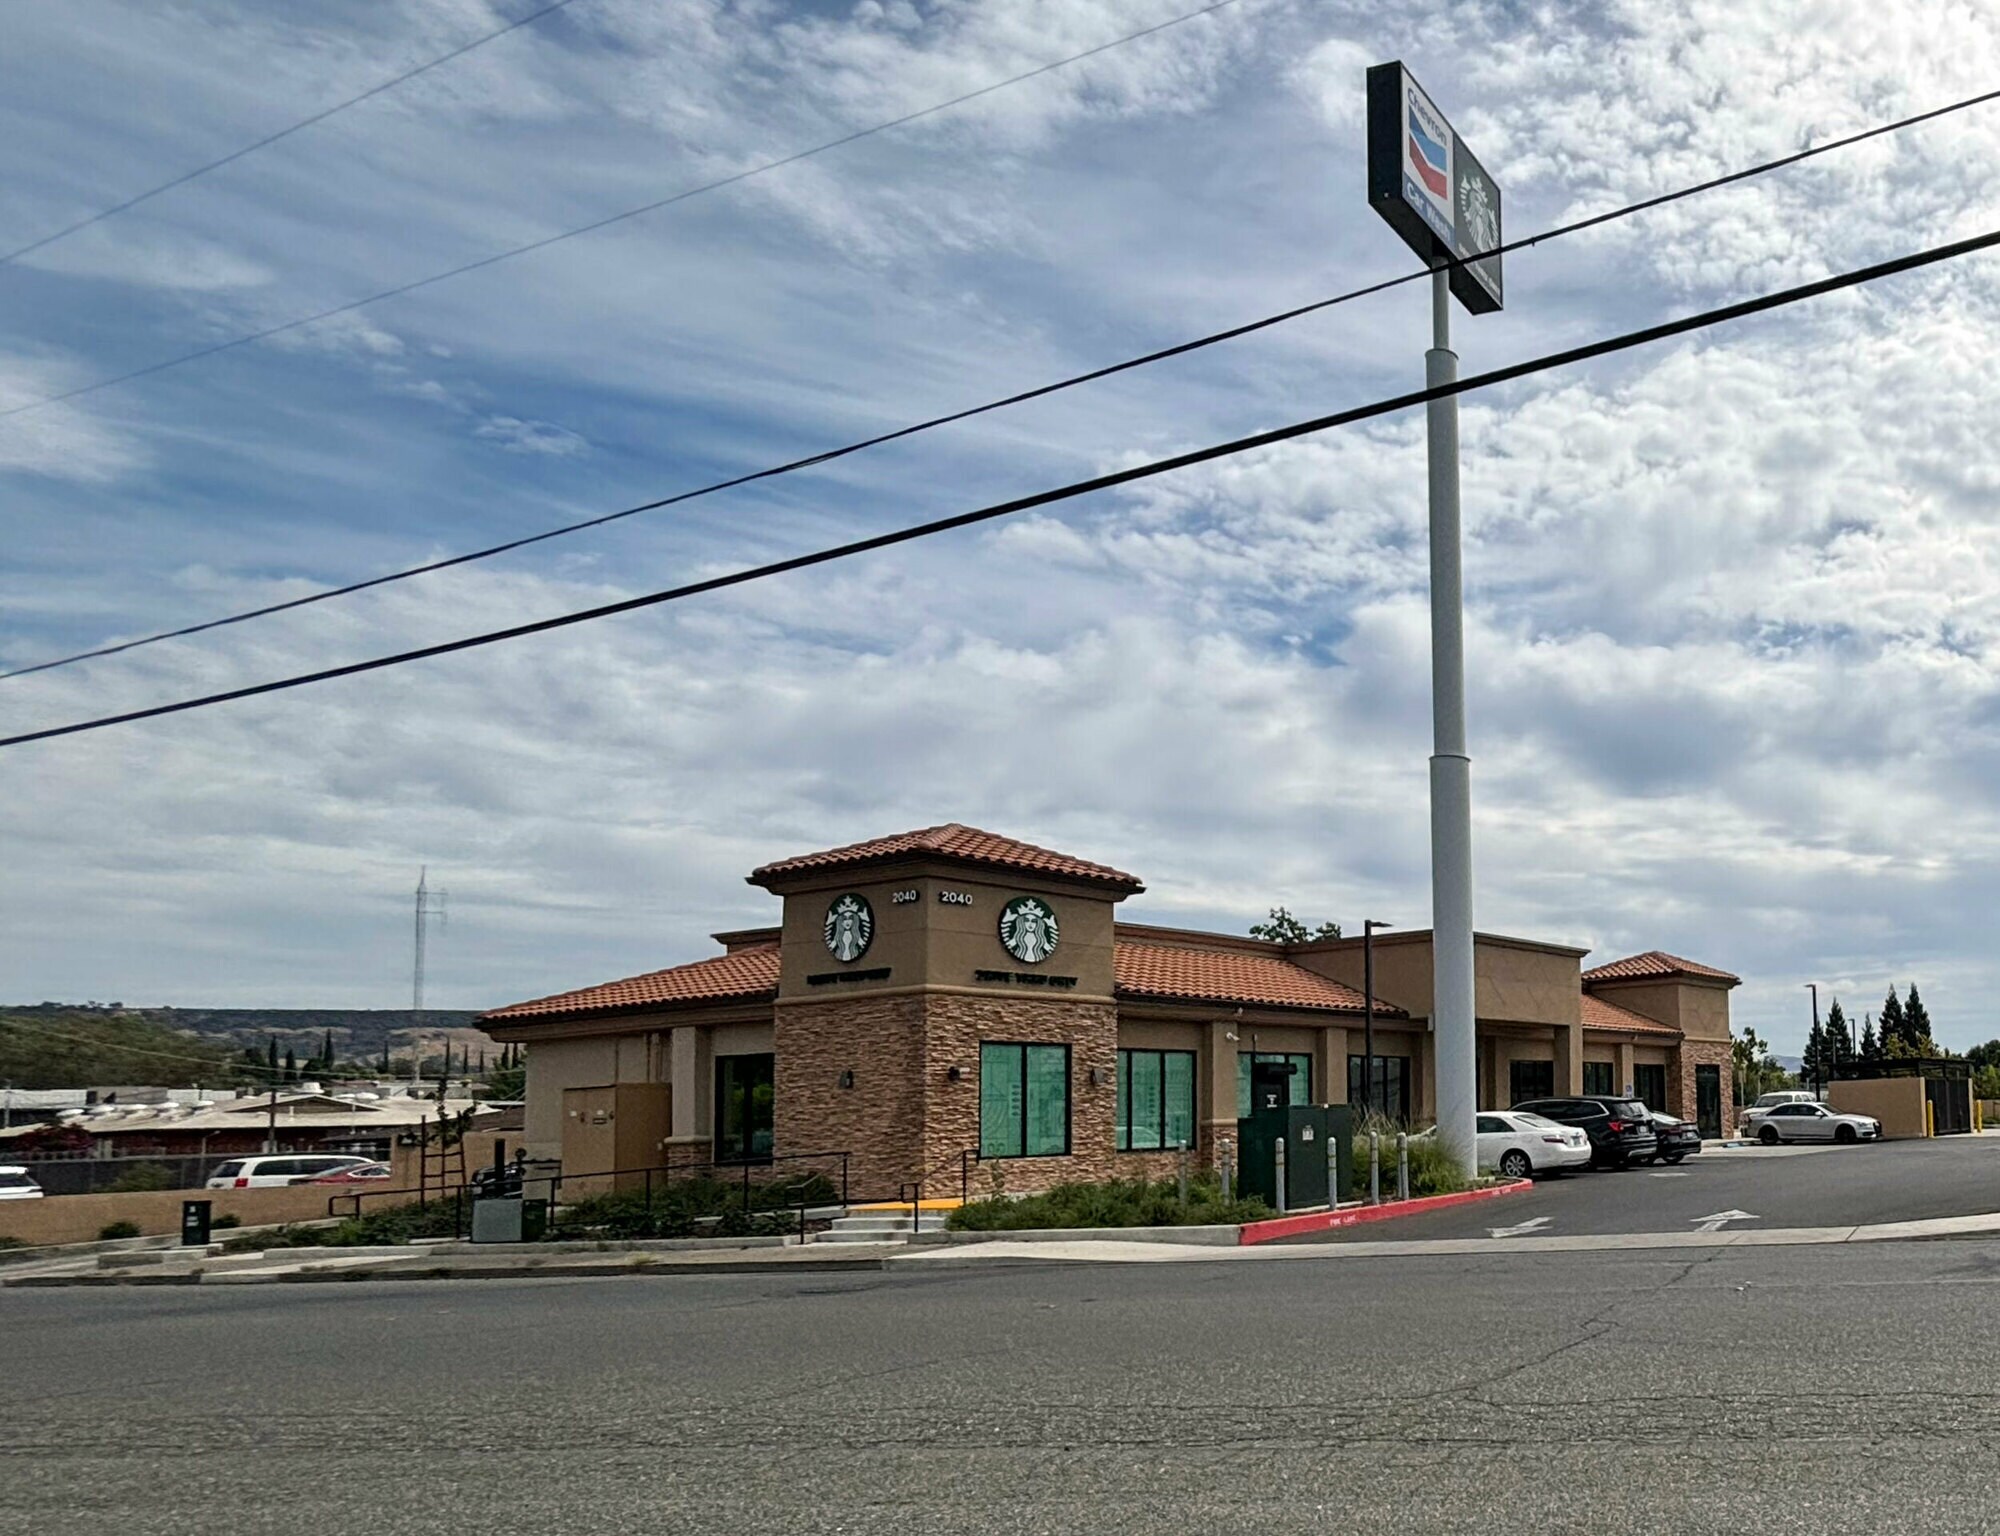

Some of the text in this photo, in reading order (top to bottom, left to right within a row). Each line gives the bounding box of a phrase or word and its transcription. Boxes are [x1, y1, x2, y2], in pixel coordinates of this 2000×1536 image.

[1407, 87, 1448, 146] Chevron
[1406, 182, 1451, 241] Car Wash
[892, 889, 917, 903] 2040
[941, 891, 973, 905] 2040
